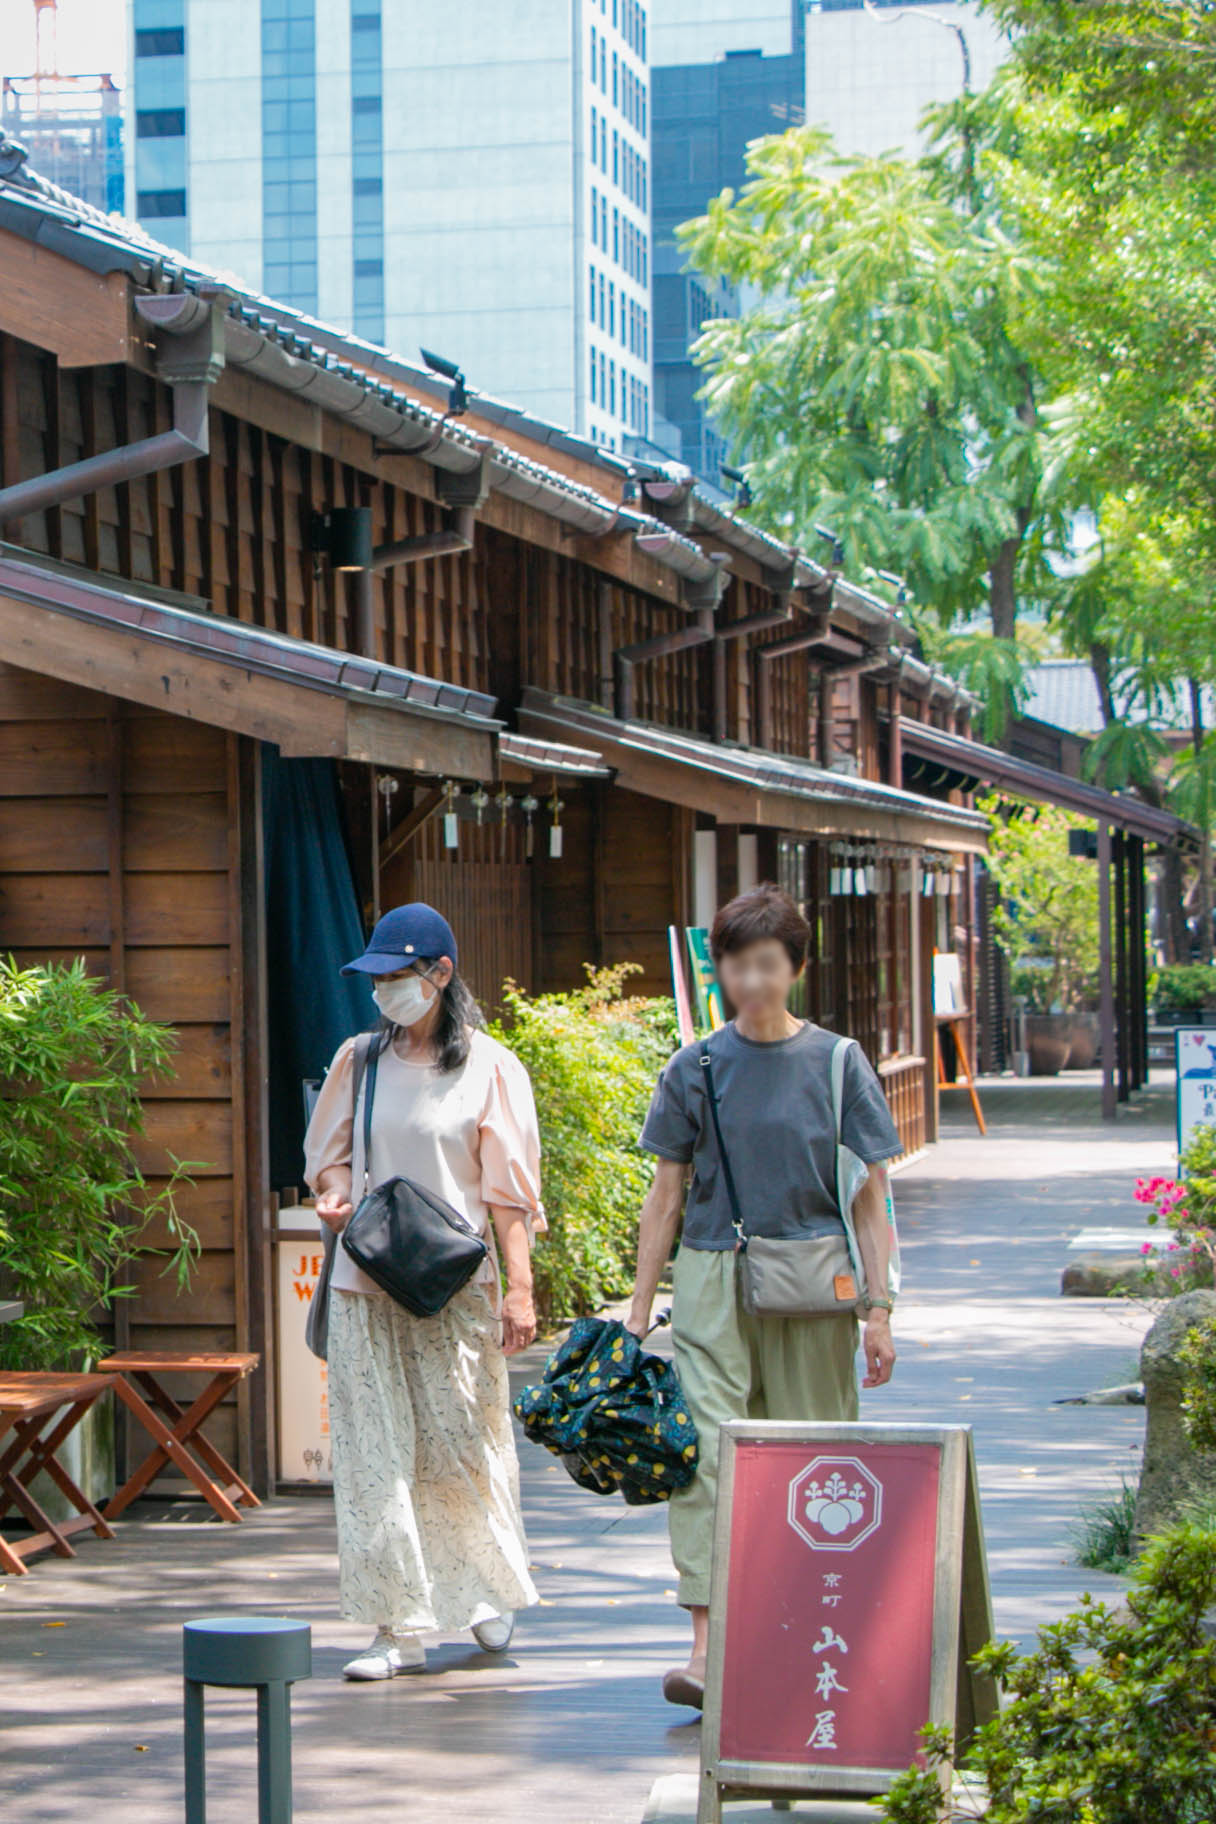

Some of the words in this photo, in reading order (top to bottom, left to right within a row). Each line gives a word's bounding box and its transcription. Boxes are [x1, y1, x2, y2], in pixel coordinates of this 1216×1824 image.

[1198, 1084, 1216, 1099] P
[821, 1572, 843, 1608] 京町
[805, 1626, 849, 1749] 山本屋
